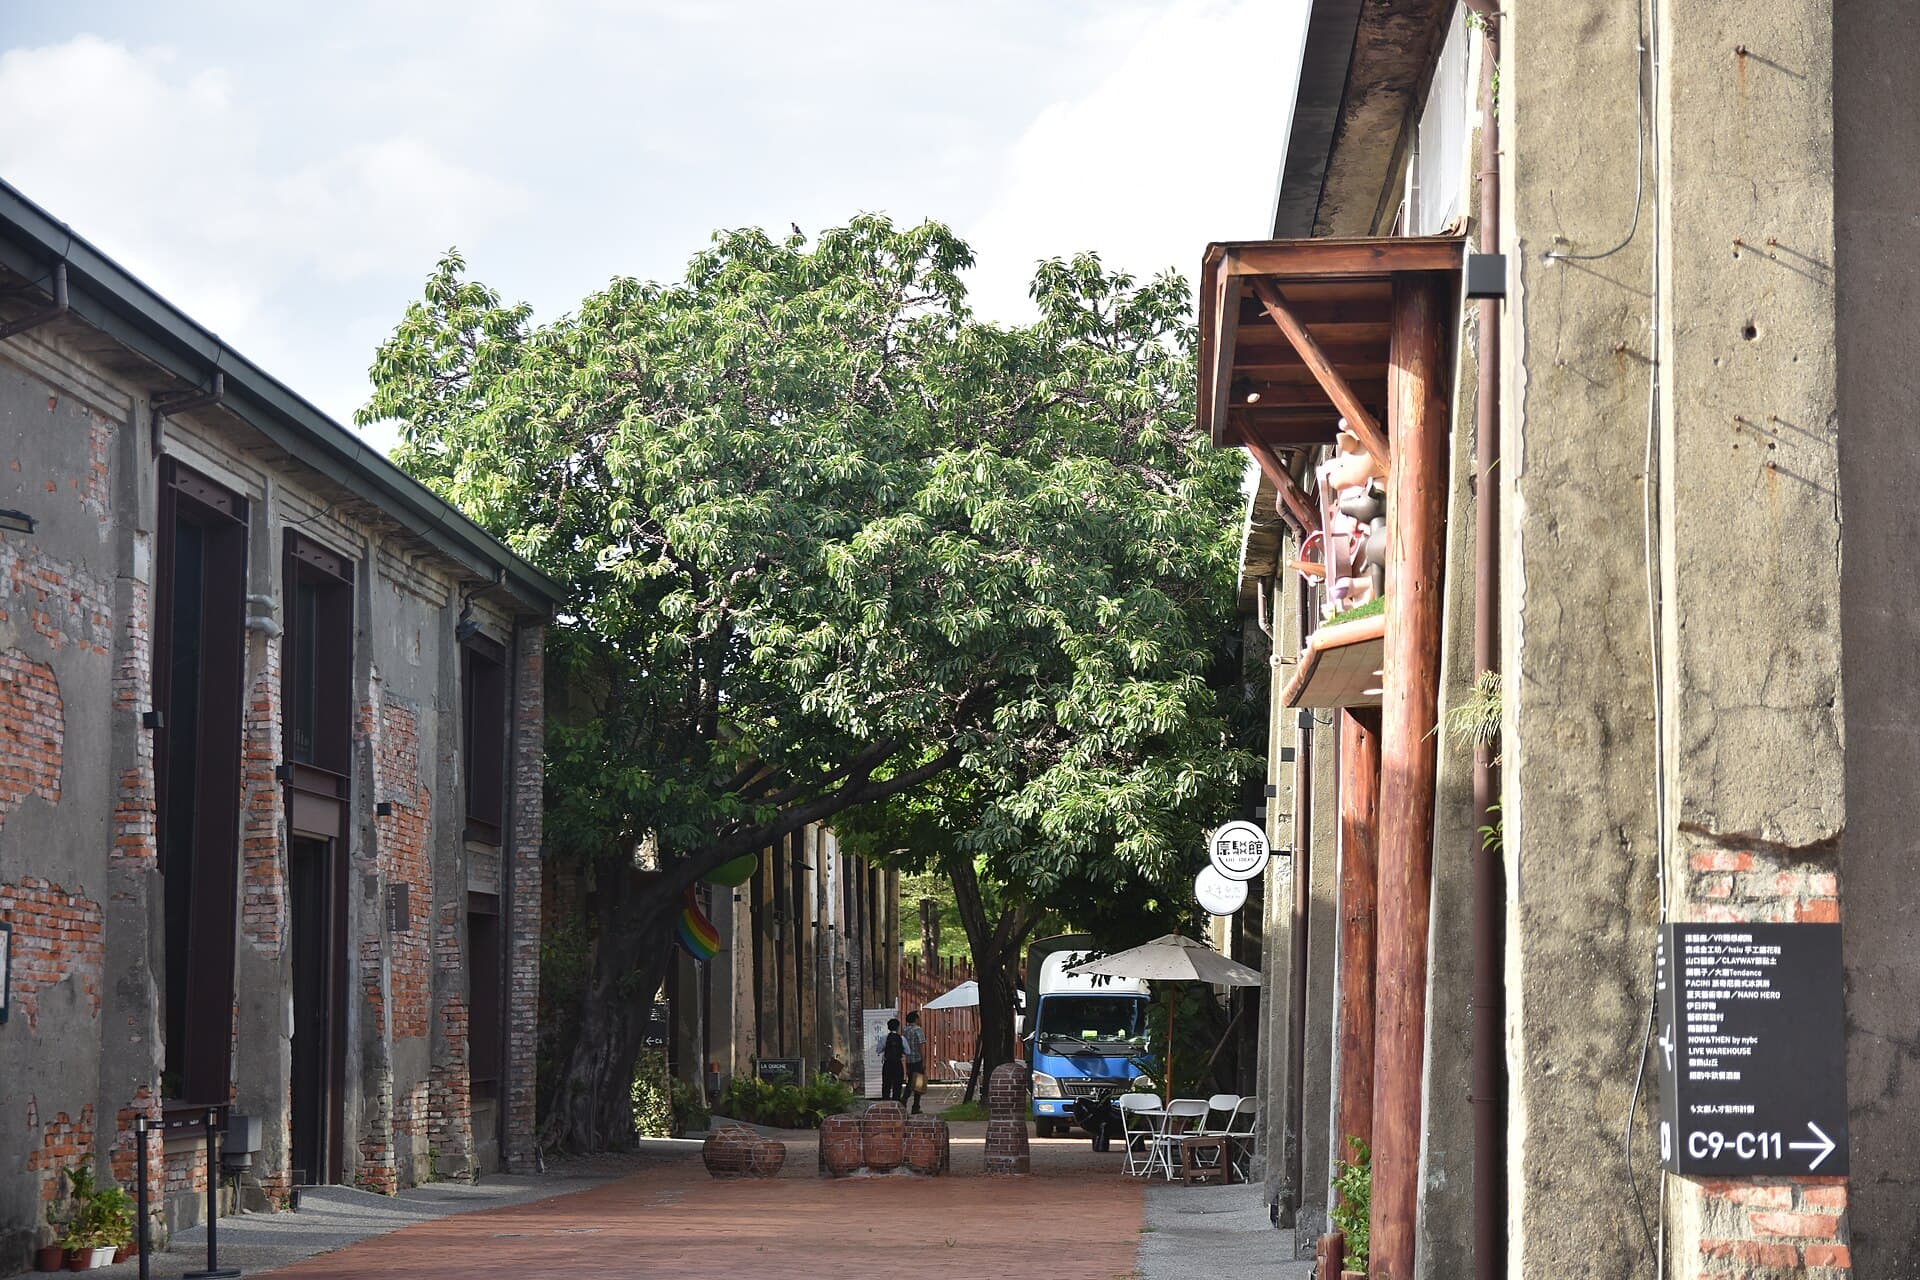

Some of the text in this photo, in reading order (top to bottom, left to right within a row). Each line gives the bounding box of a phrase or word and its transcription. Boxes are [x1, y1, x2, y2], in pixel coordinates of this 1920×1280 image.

[1759, 991, 1781, 999] HERO
[1688, 1036, 1731, 1044] NOW&THEN
[1732, 1036, 1740, 1045] by
[1688, 1047, 1751, 1055] LIVE WAREHOUSE
[1688, 1131, 1782, 1160] C9-C11
